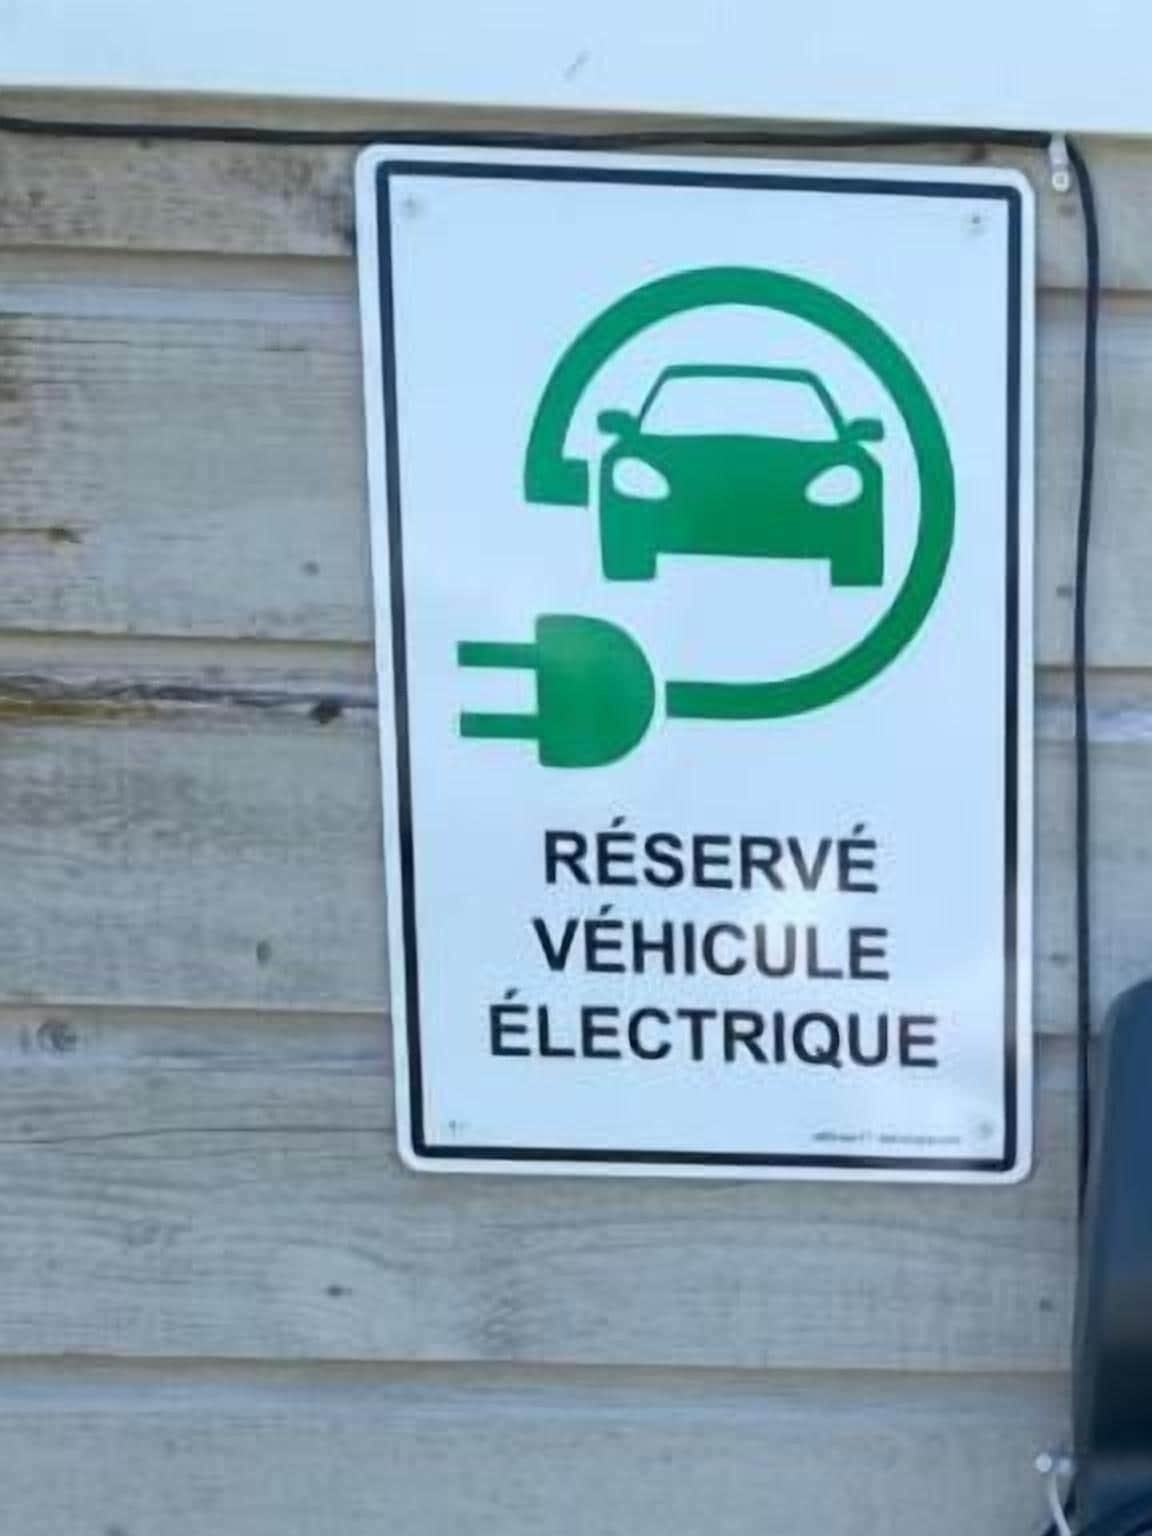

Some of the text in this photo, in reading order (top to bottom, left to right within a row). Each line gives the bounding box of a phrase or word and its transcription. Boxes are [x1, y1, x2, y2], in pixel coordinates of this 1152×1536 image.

[543, 815, 879, 894] RÉSERVÉ
[531, 903, 890, 981] VÉHICULE
[488, 988, 939, 1069] ÉLECTRIQUE
